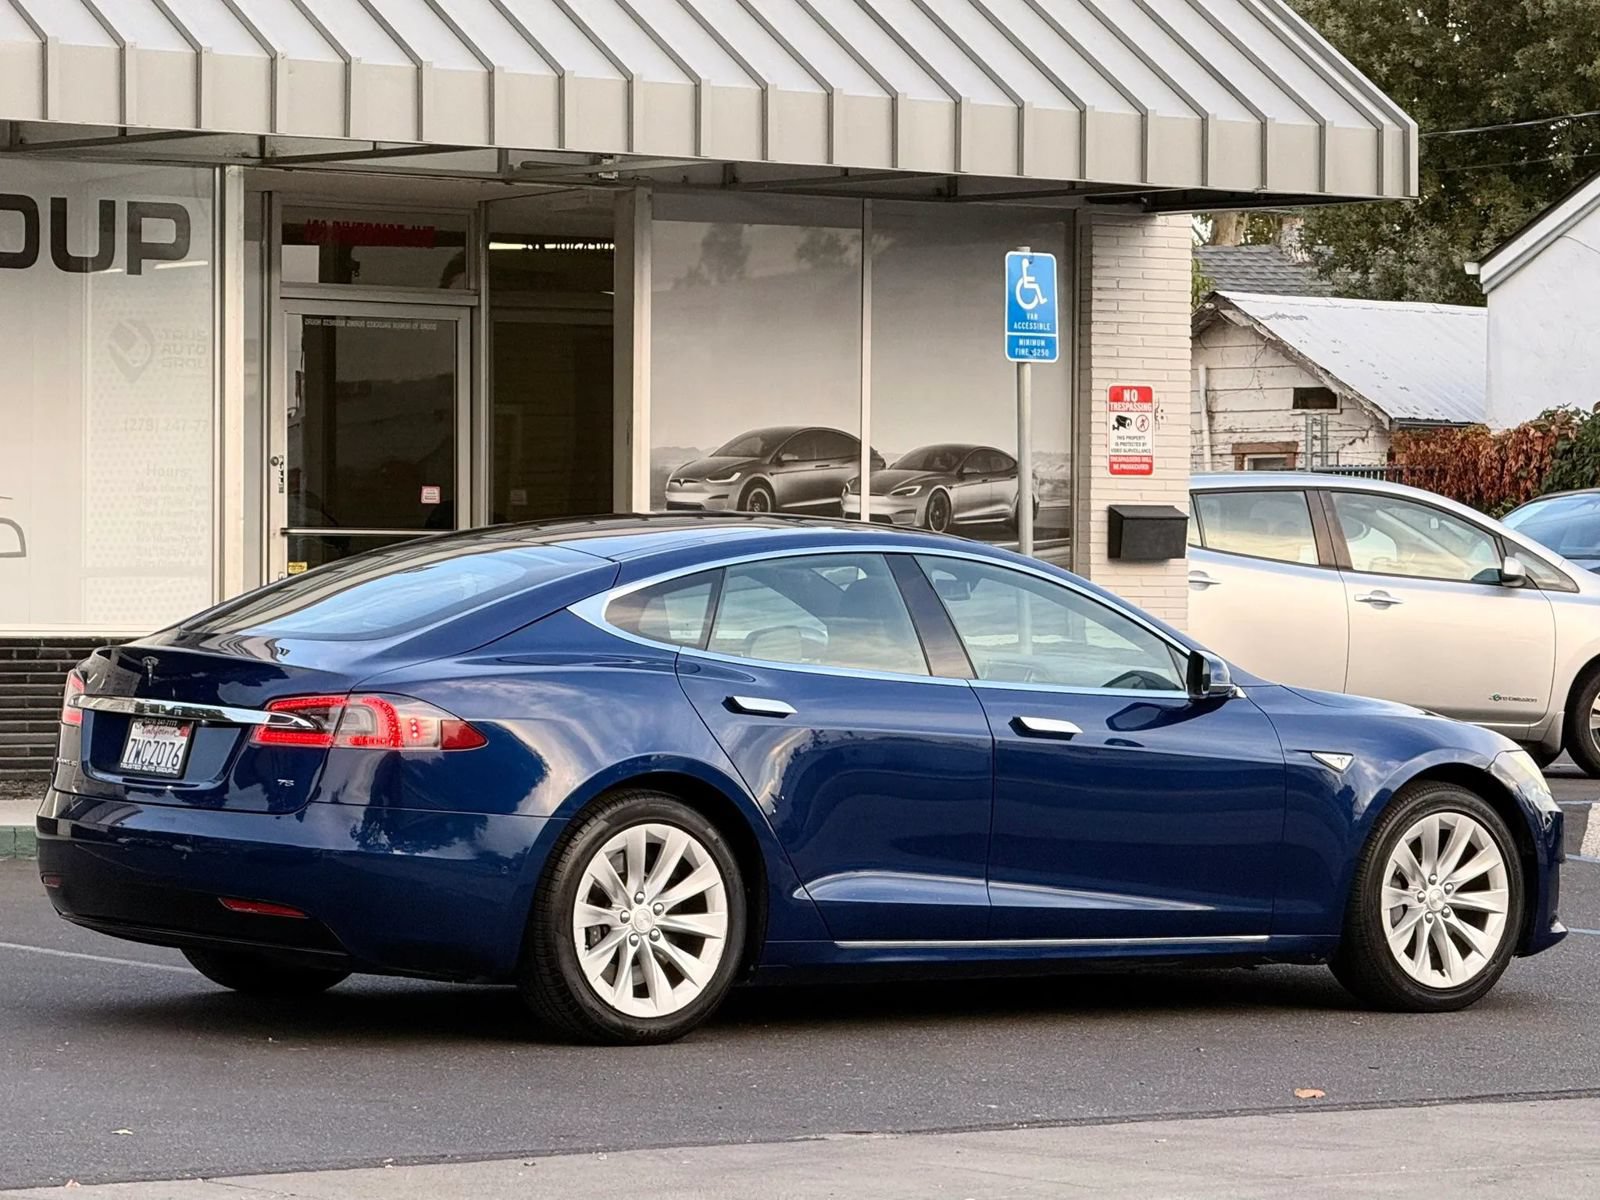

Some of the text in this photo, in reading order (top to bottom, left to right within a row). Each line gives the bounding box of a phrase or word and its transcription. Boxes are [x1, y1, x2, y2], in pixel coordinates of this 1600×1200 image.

[1026, 312, 1039, 321] VAN
[1014, 321, 1050, 331] ACCESSIBLE
[1018, 338, 1046, 347] MINIMUM
[1015, 347, 1029, 356] FINE
[1123, 389, 1138, 402] NO
[1109, 402, 1153, 412] TRESPASSING
[120, 762, 141, 770] TRUSTED
[277, 778, 295, 787] 75
